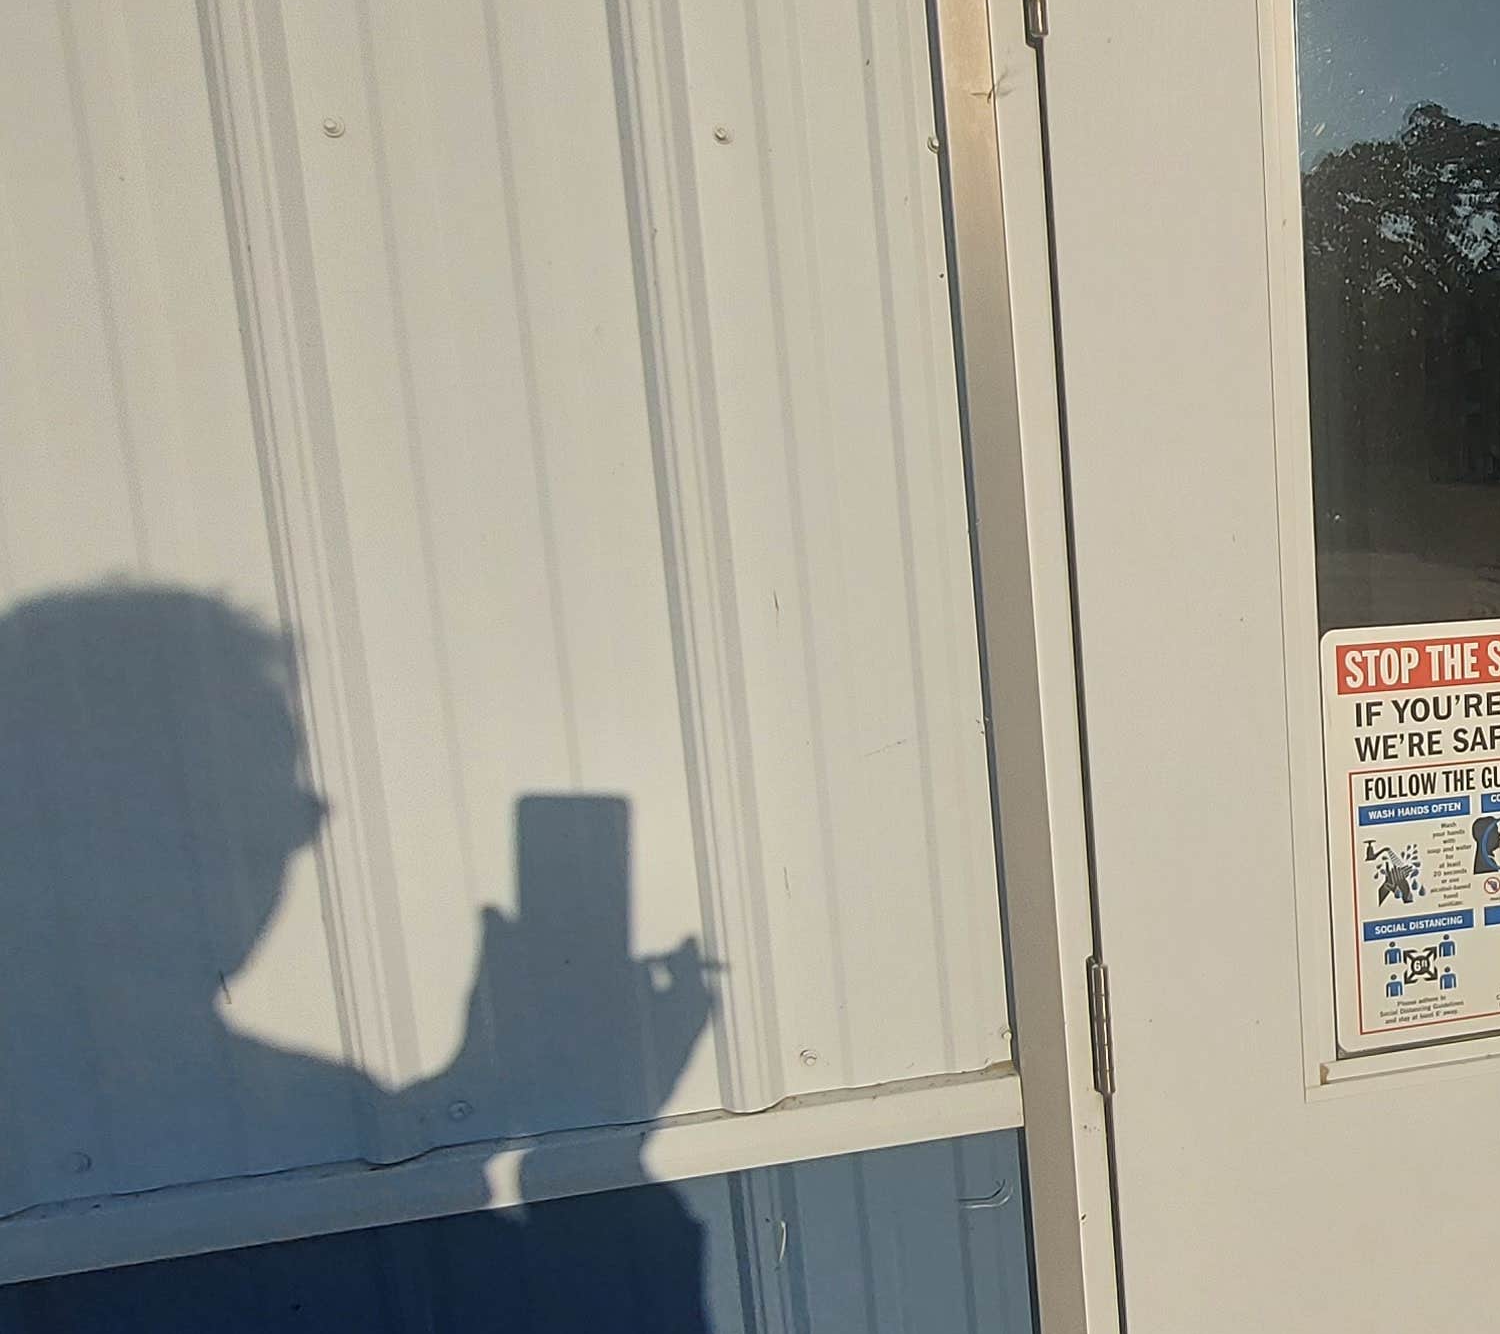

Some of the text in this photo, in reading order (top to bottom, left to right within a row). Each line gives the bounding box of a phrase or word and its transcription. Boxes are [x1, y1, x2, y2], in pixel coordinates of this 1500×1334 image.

[1344, 647, 1419, 688] STOP
[1425, 642, 1480, 681] THE
[1355, 701, 1383, 727] IF
[1354, 730, 1442, 761] WE'RE
[1364, 771, 1437, 800] FOLLOW
[1441, 768, 1475, 792] THE
[1368, 802, 1462, 820] WASH HANDS OFTEN
[1375, 915, 1463, 935] SOCIAL DISTANCING
